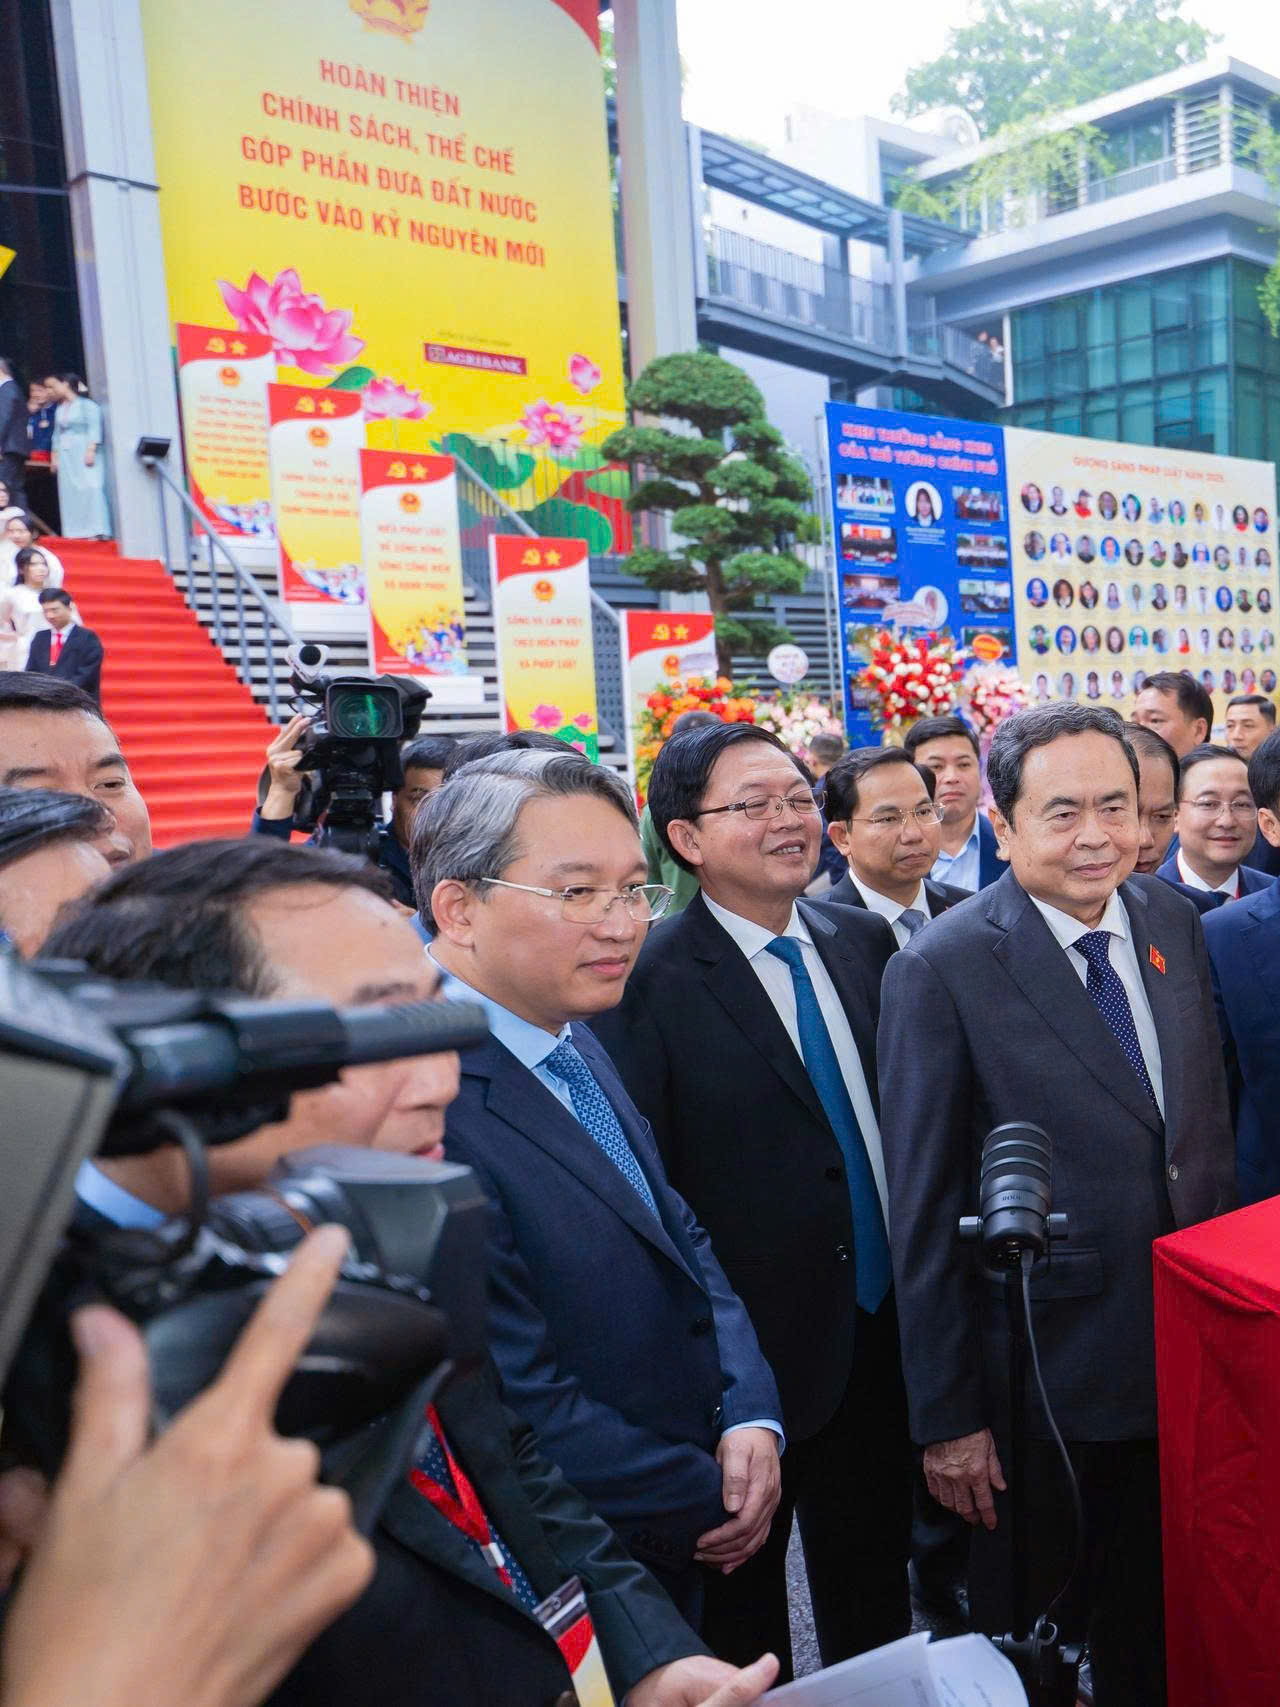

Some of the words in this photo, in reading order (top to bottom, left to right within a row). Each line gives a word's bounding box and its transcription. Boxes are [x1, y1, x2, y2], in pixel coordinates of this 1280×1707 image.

[319, 58, 387, 97] HOÀN
[394, 79, 460, 118] THIỆN
[261, 92, 341, 133] CHÍNH
[349, 112, 421, 156] SÁCH,
[425, 131, 468, 164] THỂ
[473, 144, 516, 176] CHẾ
[241, 134, 292, 167] GÓP
[301, 149, 370, 187] PHẦN
[377, 167, 424, 199] ĐƯA
[431, 177, 472, 209] ĐẤT
[479, 190, 539, 224] NƯỚC
[239, 184, 308, 221] BƯỚC
[316, 199, 364, 231] VÀO
[409, 219, 499, 259] NGUYÊN
[505, 239, 546, 269] MỚI
